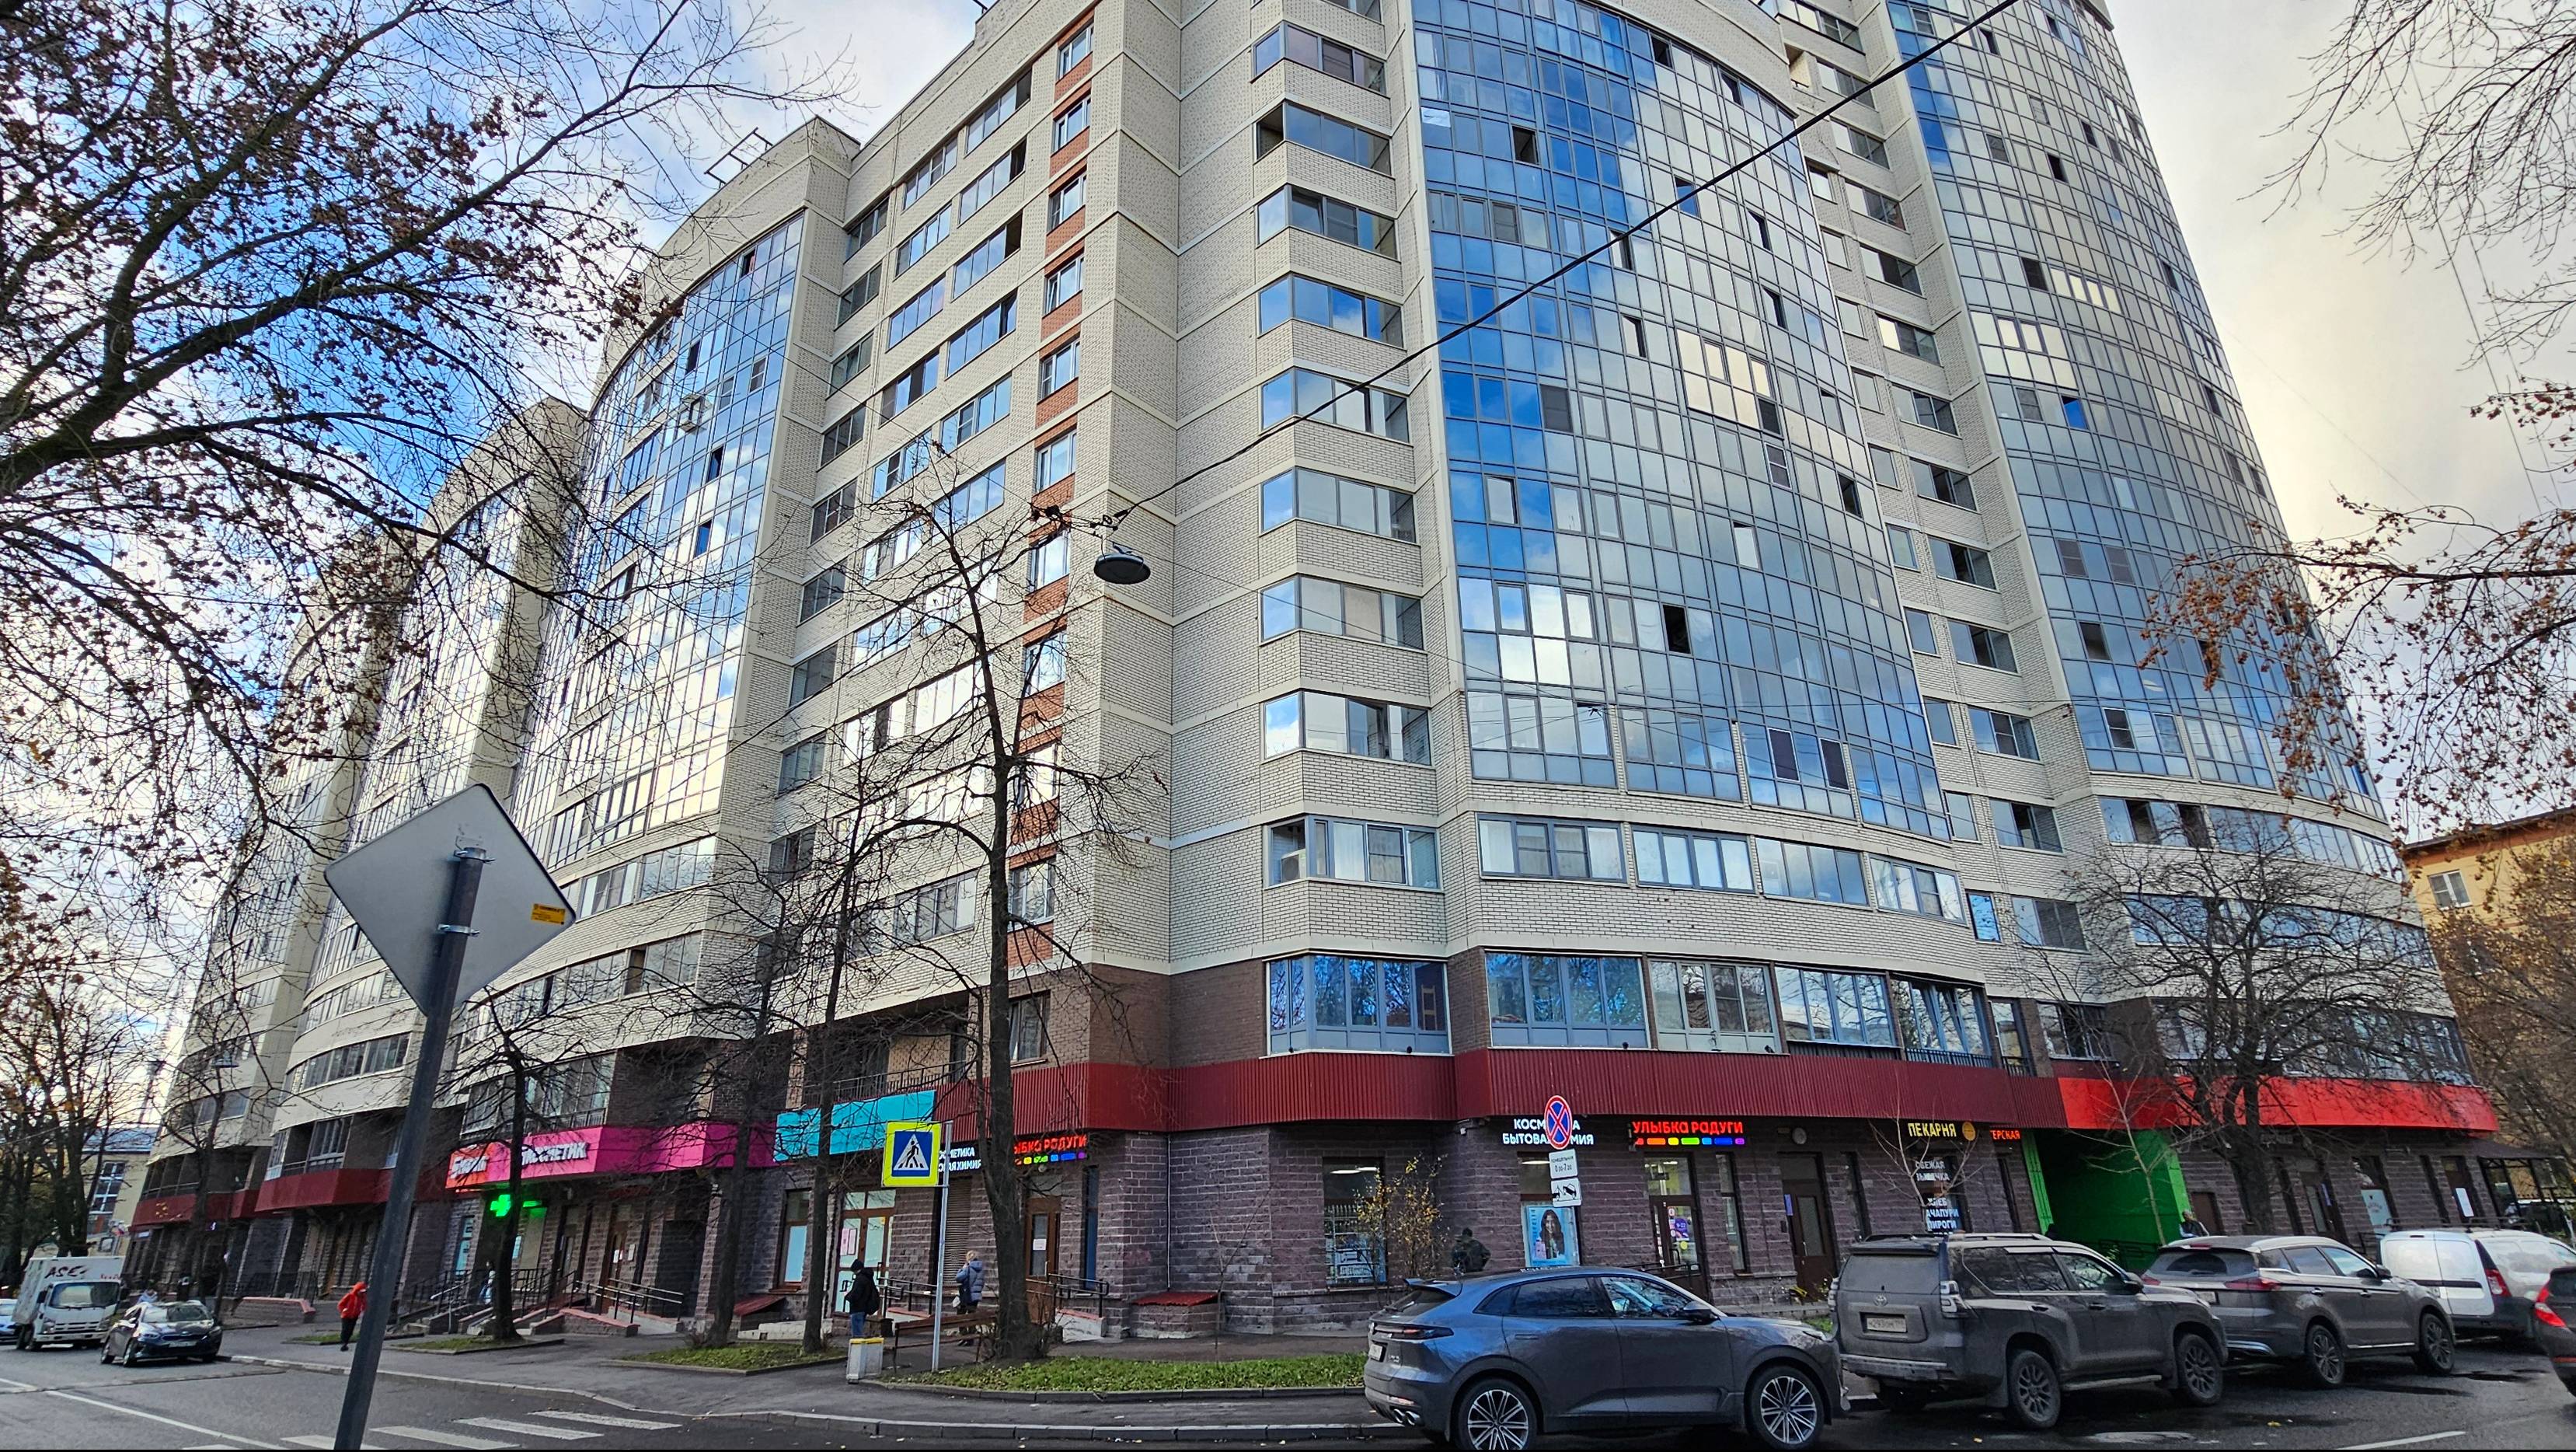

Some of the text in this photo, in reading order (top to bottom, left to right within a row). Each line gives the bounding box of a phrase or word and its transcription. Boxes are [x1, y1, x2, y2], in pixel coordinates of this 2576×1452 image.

[1514, 1119, 1581, 1130] КОСМА
[1907, 1122, 1957, 1137] ПЕКАРНЯ
[1502, 1133, 1551, 1145] БЫТОВА
[1990, 1129, 2020, 1140] ЕРСКАЯ
[1926, 1209, 1959, 1217] АЧАПУРИ
[1927, 1220, 1957, 1230] ПИРОГИ
